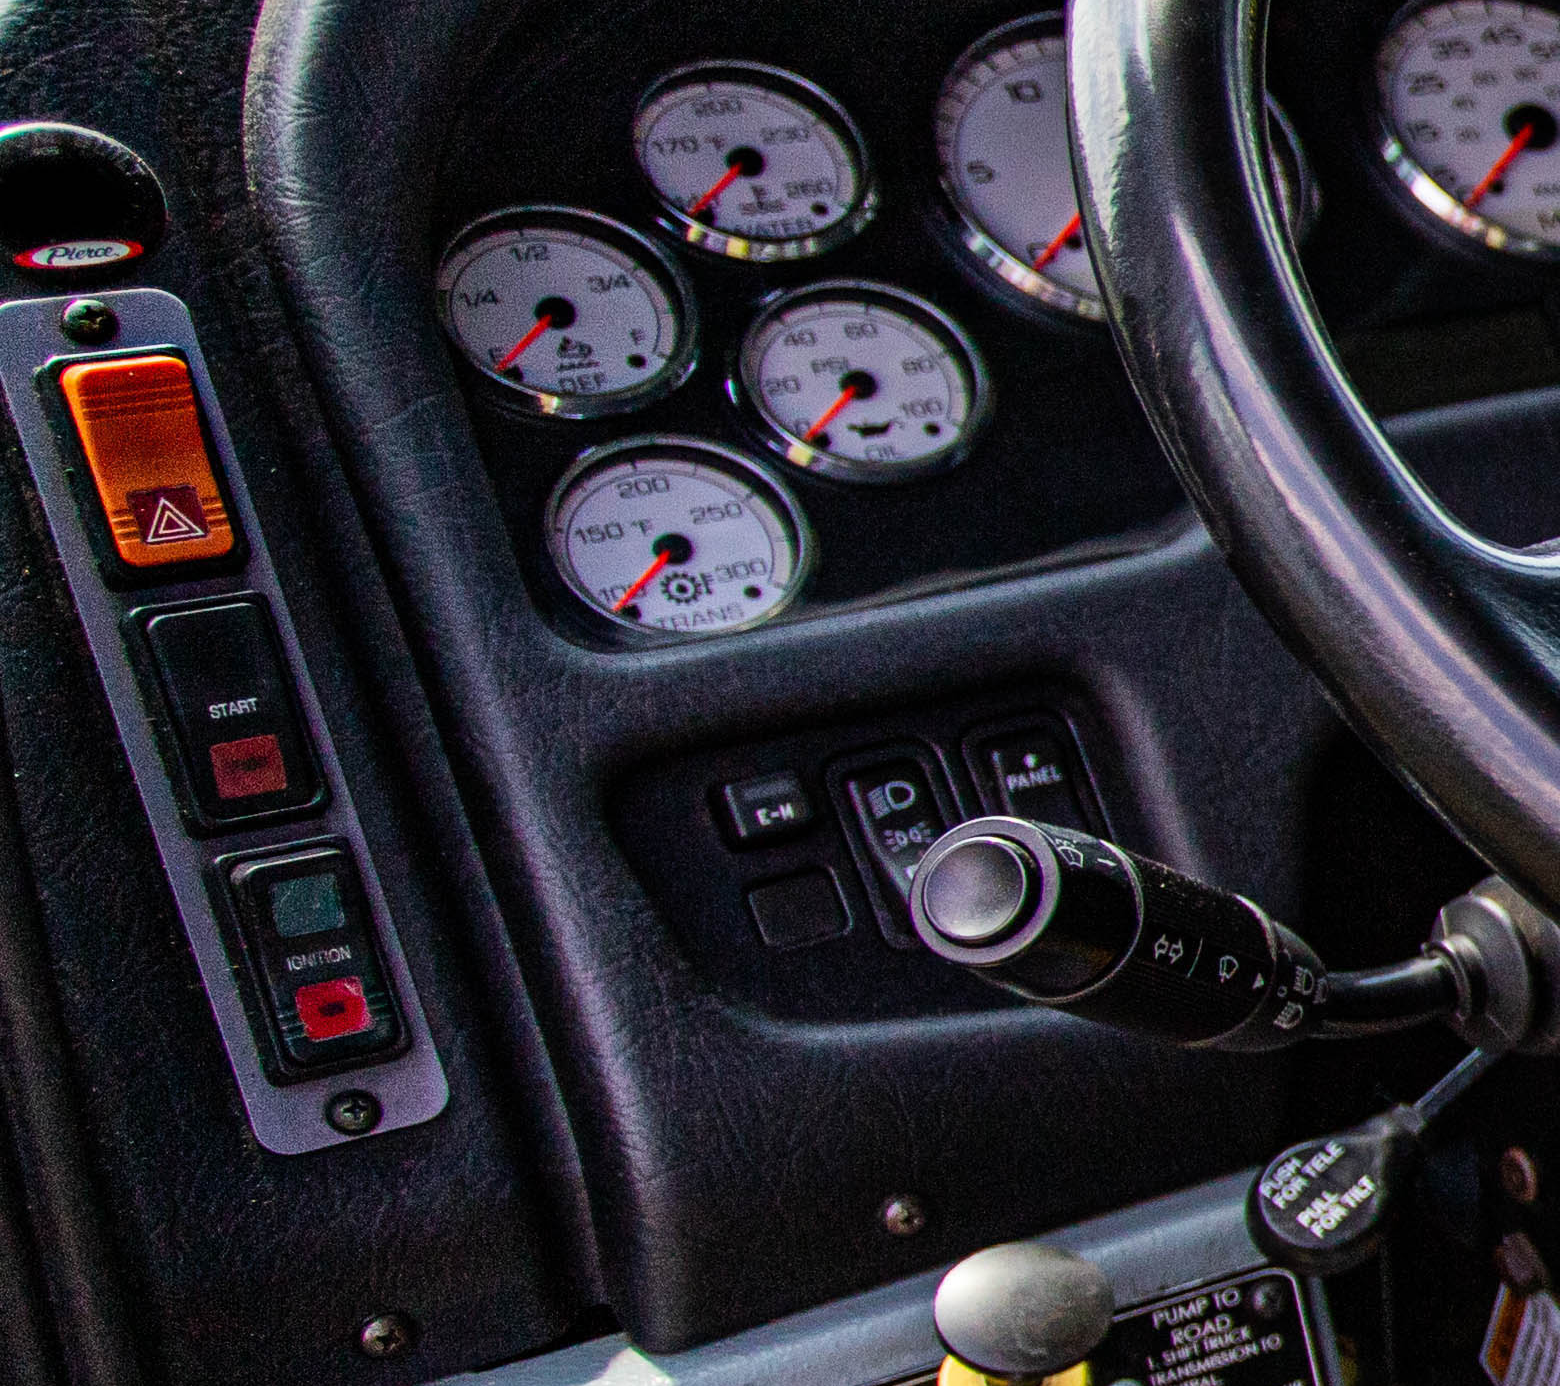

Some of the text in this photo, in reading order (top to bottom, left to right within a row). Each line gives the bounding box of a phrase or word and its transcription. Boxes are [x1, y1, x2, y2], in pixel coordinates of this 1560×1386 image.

[47, 245, 116, 264] Pierce
[617, 477, 670, 499] 200
[690, 501, 742, 524] 250
[574, 522, 624, 544] 150
[655, 603, 745, 629] TRANS
[208, 696, 258, 720] START
[1006, 765, 1062, 790] PANEL
[286, 944, 352, 973] IGNITION
[1259, 1156, 1303, 1199] PUSH
[1271, 1140, 1345, 1210] FOR TELE
[1296, 1190, 1340, 1228] PULL
[1310, 1174, 1377, 1239] FOR TILT
[1152, 1287, 1242, 1330] PUMP TO
[1170, 1314, 1232, 1347] ROAD
[1260, 1332, 1283, 1353] TO
[1161, 1344, 1200, 1365] SHIFT
[1202, 1325, 1251, 1353] TRUCK
